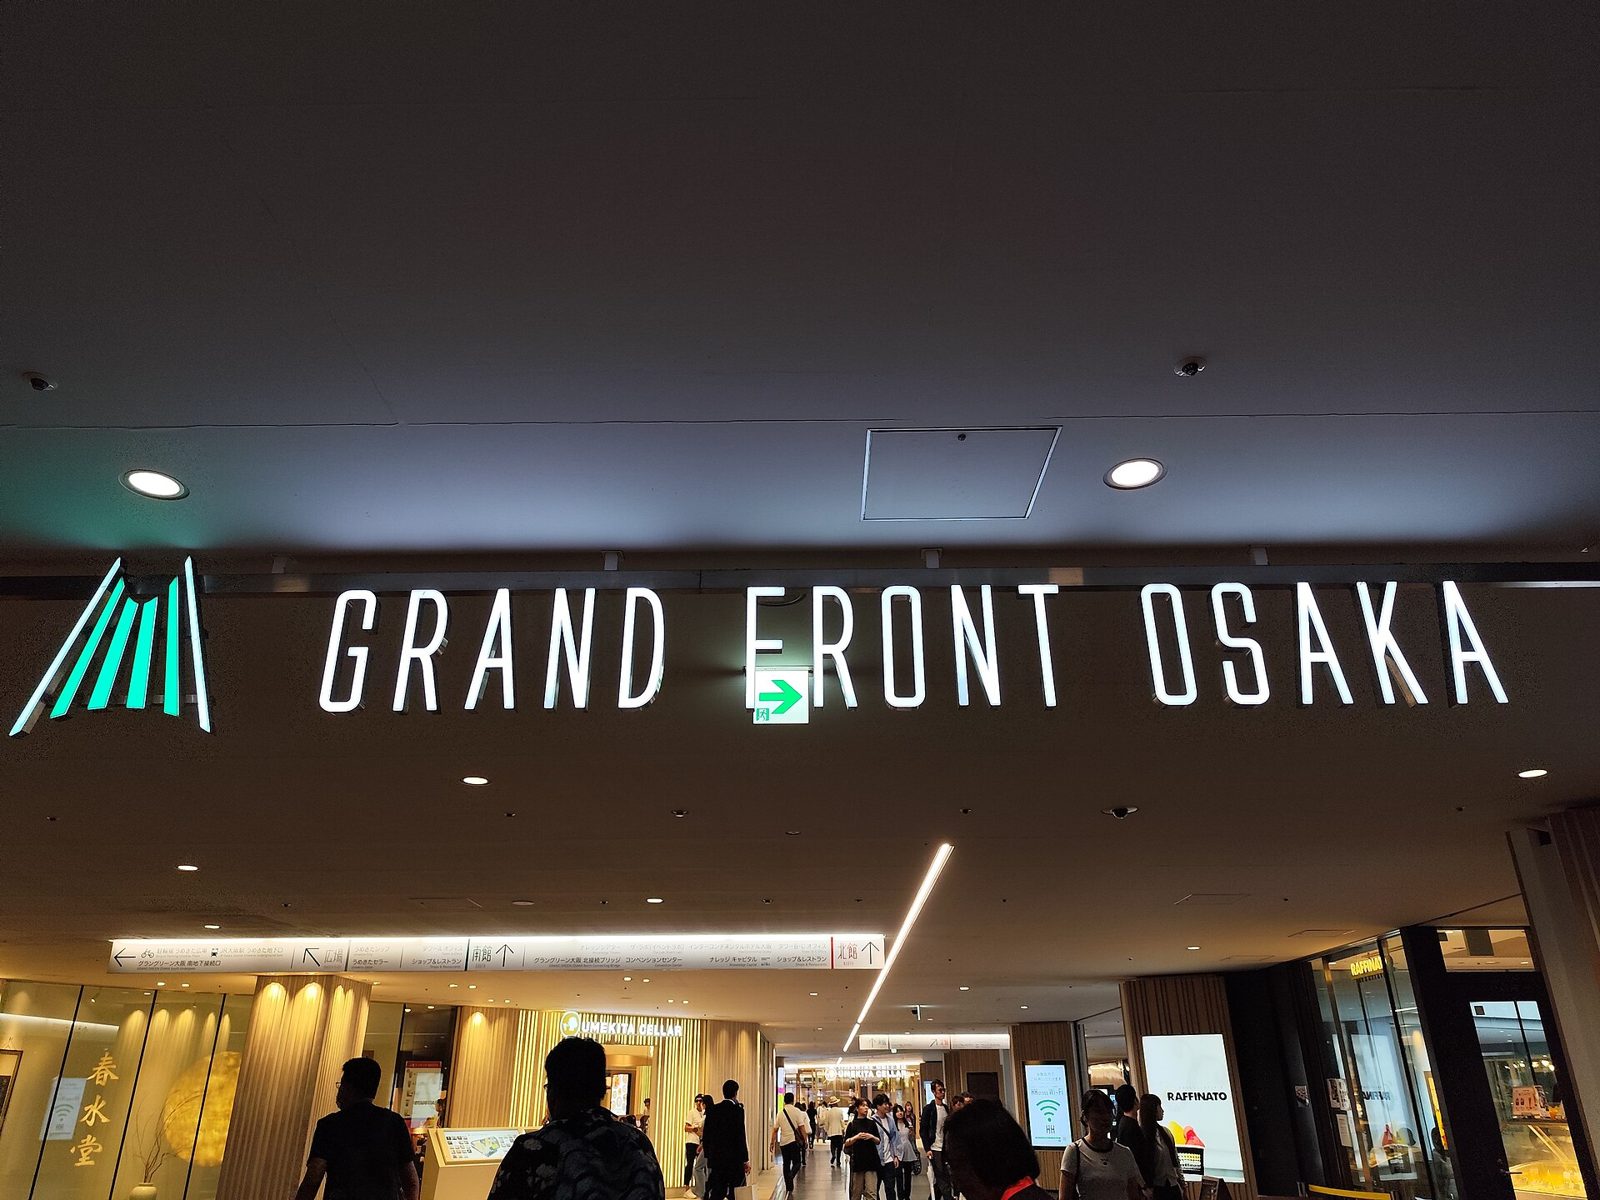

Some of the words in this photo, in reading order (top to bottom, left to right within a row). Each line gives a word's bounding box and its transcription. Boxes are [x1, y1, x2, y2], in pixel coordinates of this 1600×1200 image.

[319, 587, 666, 713] GRAND
[745, 585, 1060, 709] FRONT
[1142, 581, 1508, 707] OSAKA
[472, 945, 493, 962] 南館
[838, 943, 858, 960] 北館
[581, 1021, 636, 1035] UMEKITA
[639, 1023, 683, 1037] CELLAR
[1167, 1091, 1227, 1101] RAFFINATO
[70, 1051, 119, 1167] 春水堂
